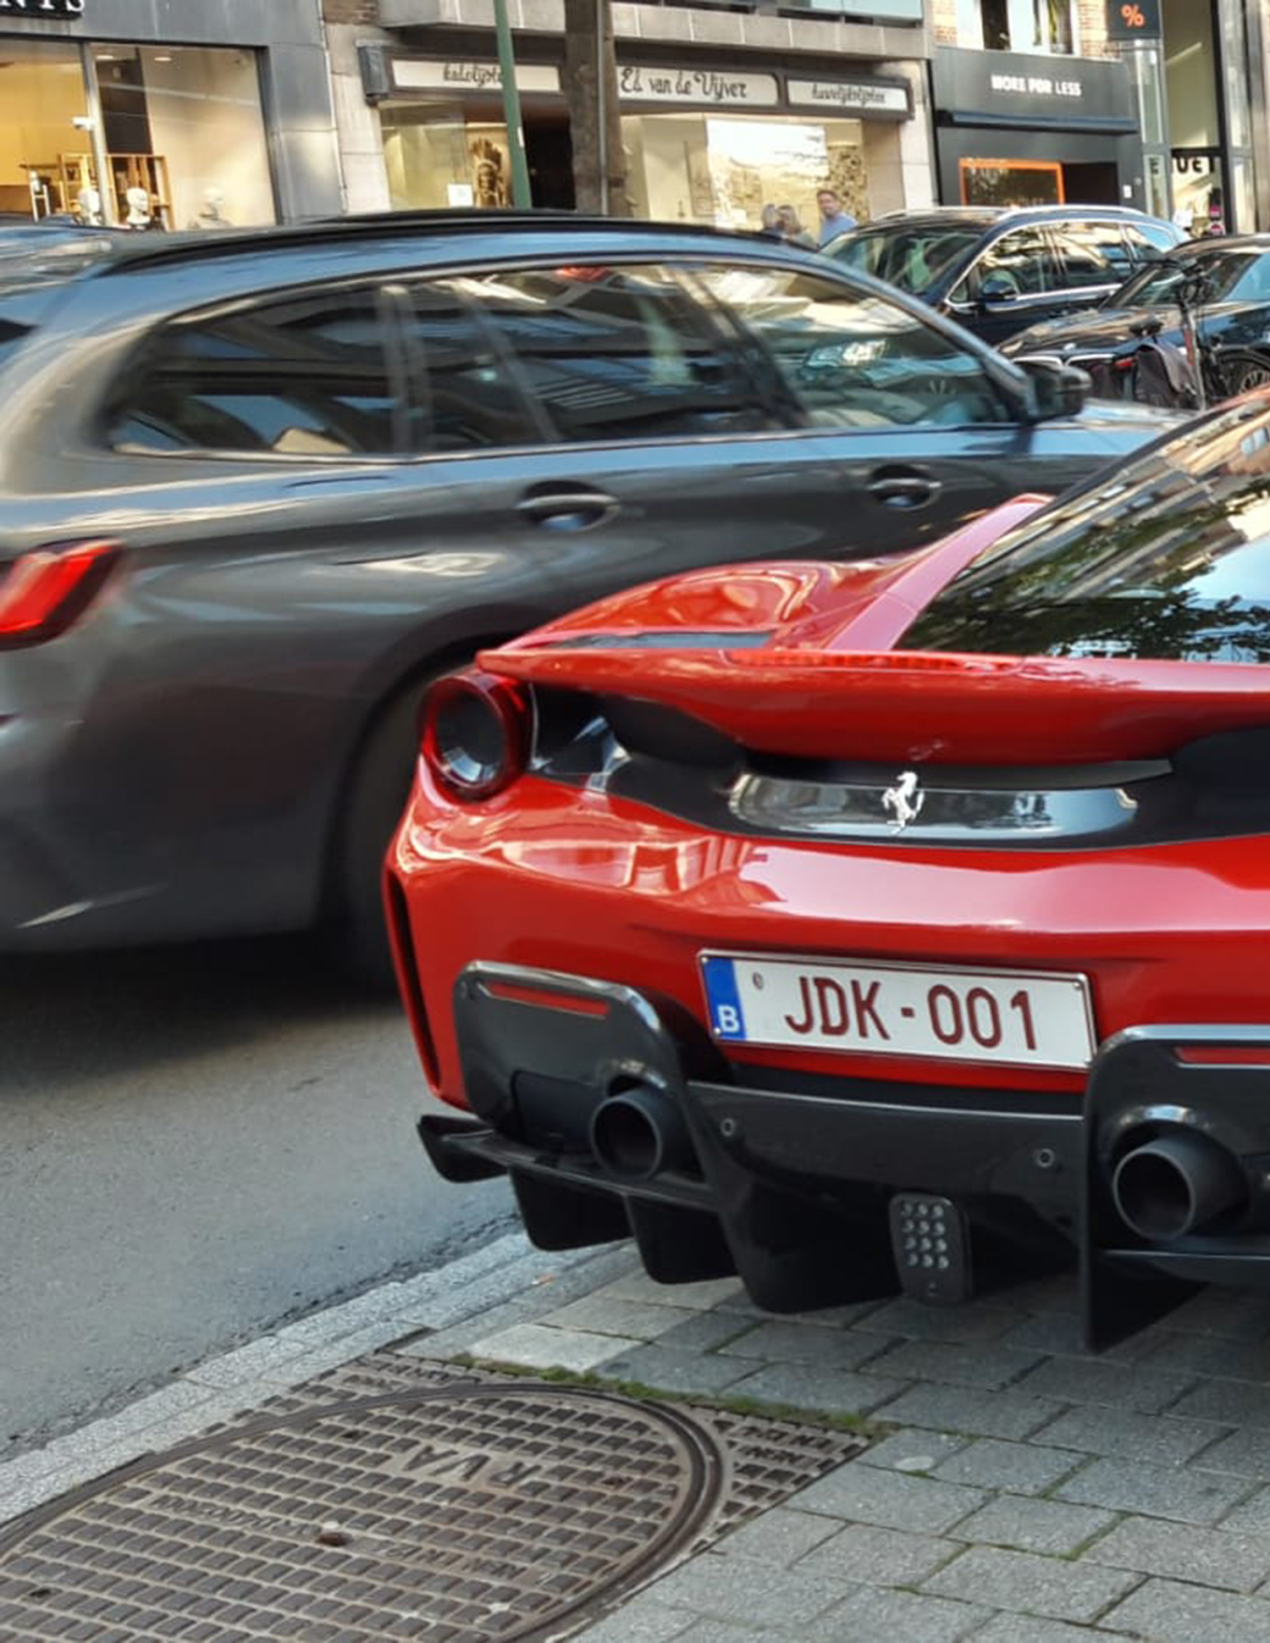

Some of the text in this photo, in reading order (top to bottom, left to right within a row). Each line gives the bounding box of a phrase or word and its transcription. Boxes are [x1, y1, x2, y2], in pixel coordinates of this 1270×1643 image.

[1121, 4, 1144, 27] %
[649, 78, 671, 94] van
[675, 70, 691, 95] de
[693, 70, 747, 101] Vijver
[1028, 77, 1052, 94] FOR
[1055, 81, 1082, 96] LESS
[716, 1005, 740, 1033] B
[784, 976, 1038, 1051] JDK-001
